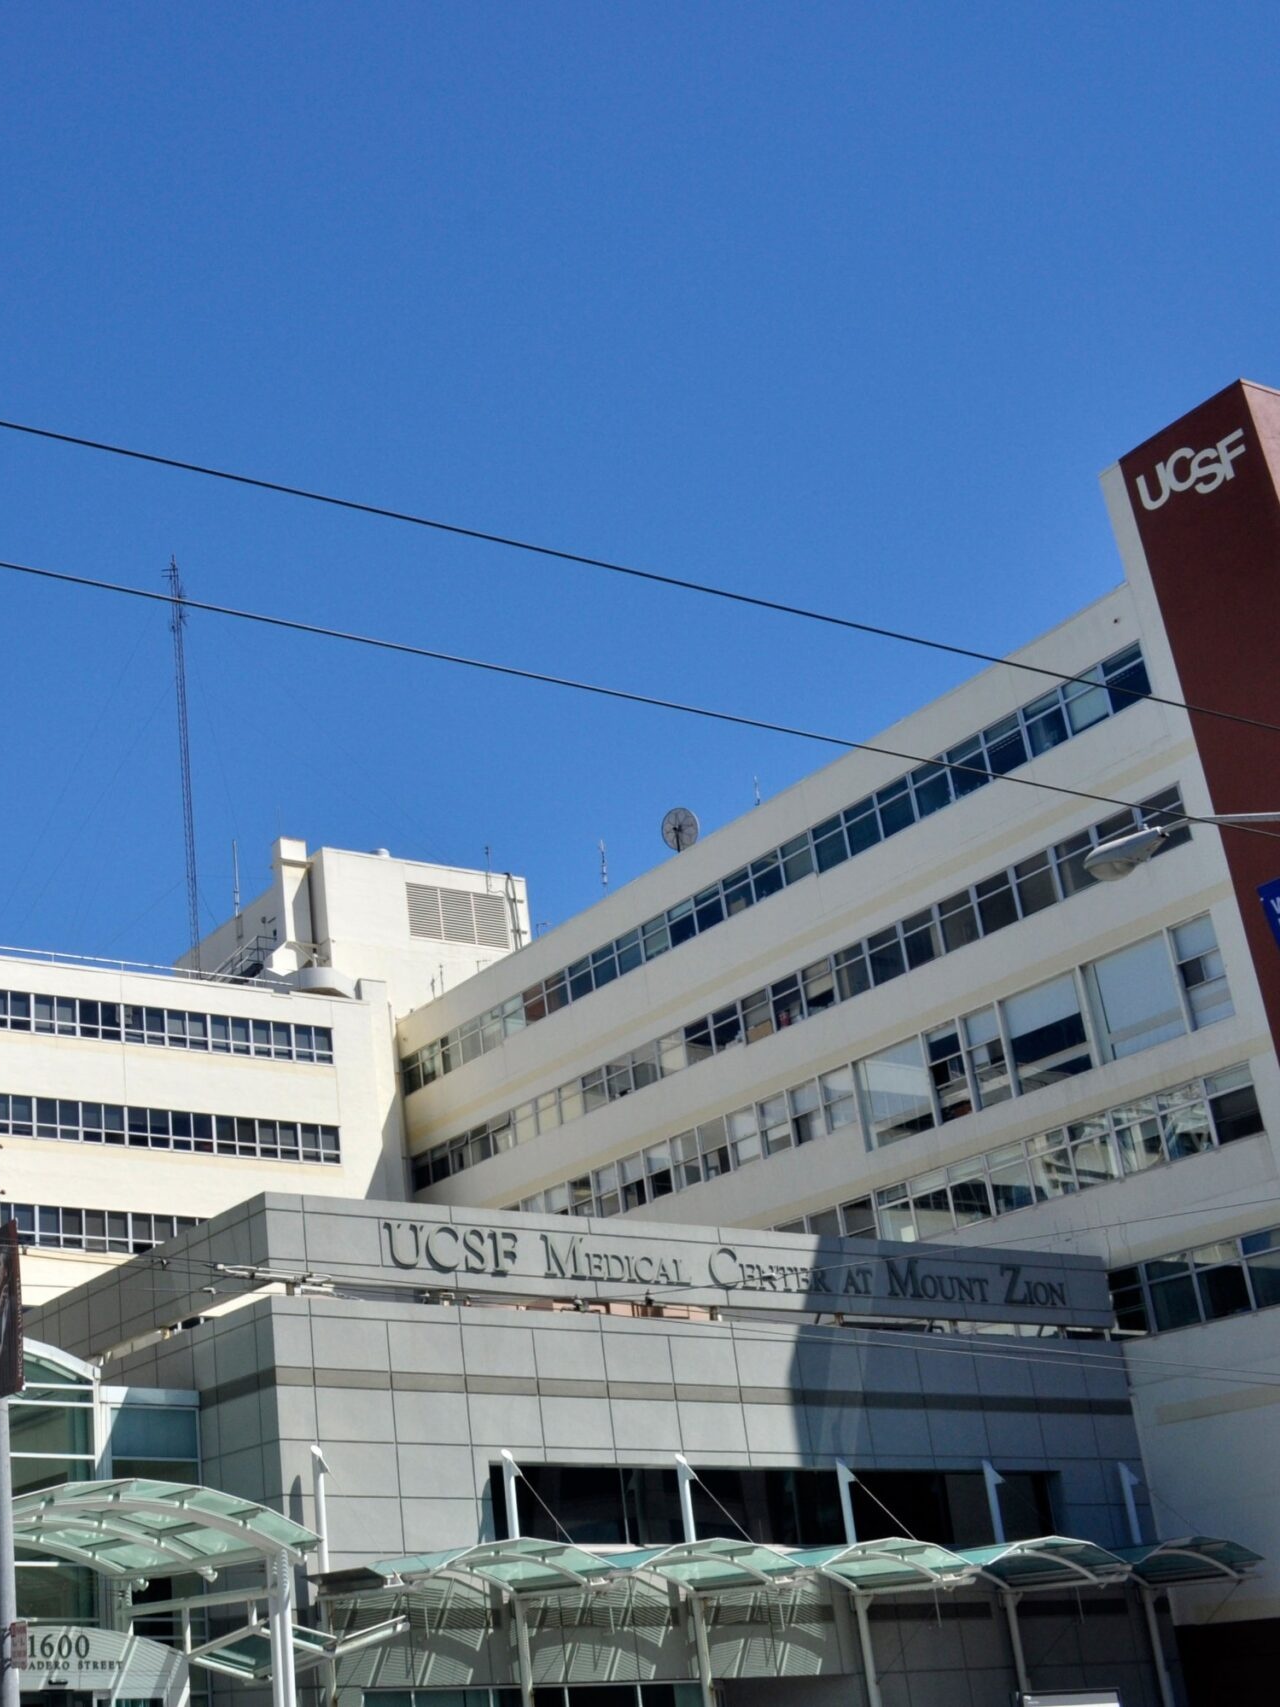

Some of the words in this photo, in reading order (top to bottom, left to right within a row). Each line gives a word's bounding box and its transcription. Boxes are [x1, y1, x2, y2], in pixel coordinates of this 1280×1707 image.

[1136, 427, 1246, 511] UCSF
[383, 1221, 519, 1277] UCSF
[28, 1634, 90, 1659] 1600
[77, 1660, 123, 1671] STREET
